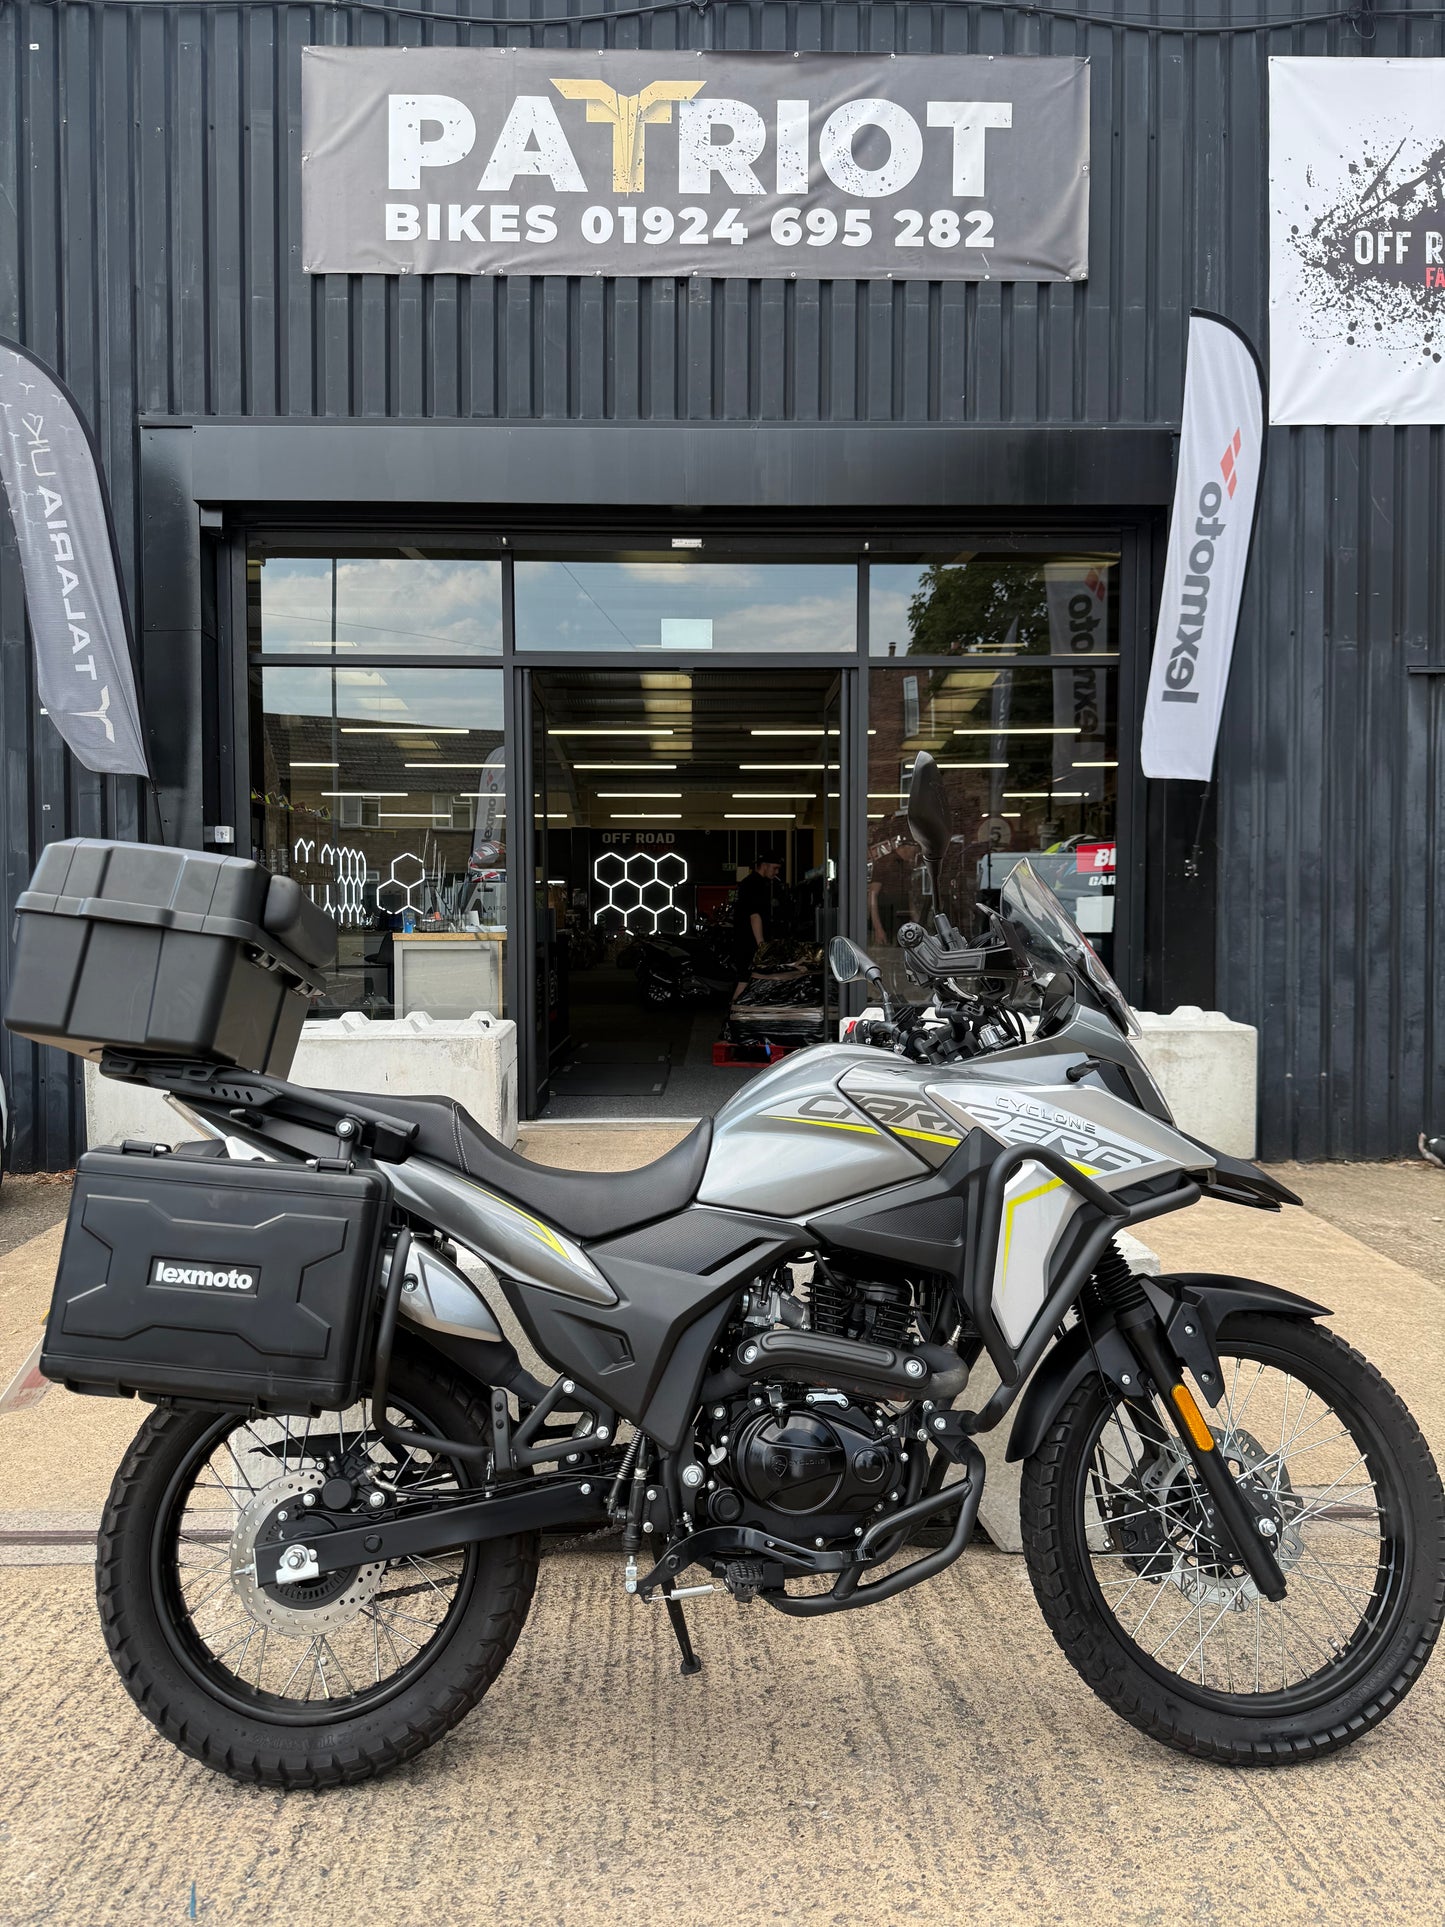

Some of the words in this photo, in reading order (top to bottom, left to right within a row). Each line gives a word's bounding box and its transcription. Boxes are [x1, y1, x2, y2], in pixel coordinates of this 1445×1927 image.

[387, 78, 1012, 197] PATRIOT
[385, 203, 557, 242] BIKES
[580, 205, 748, 245] 01924
[770, 208, 873, 247] 695
[893, 208, 995, 248] 282
[1354, 230, 1412, 265] OFF
[481, 783, 499, 843] lexmoo
[602, 832, 632, 844] OFF
[635, 832, 676, 844] ROAD
[995, 1095, 1097, 1135] CYCLONE
[155, 1261, 253, 1290] lexmoto
